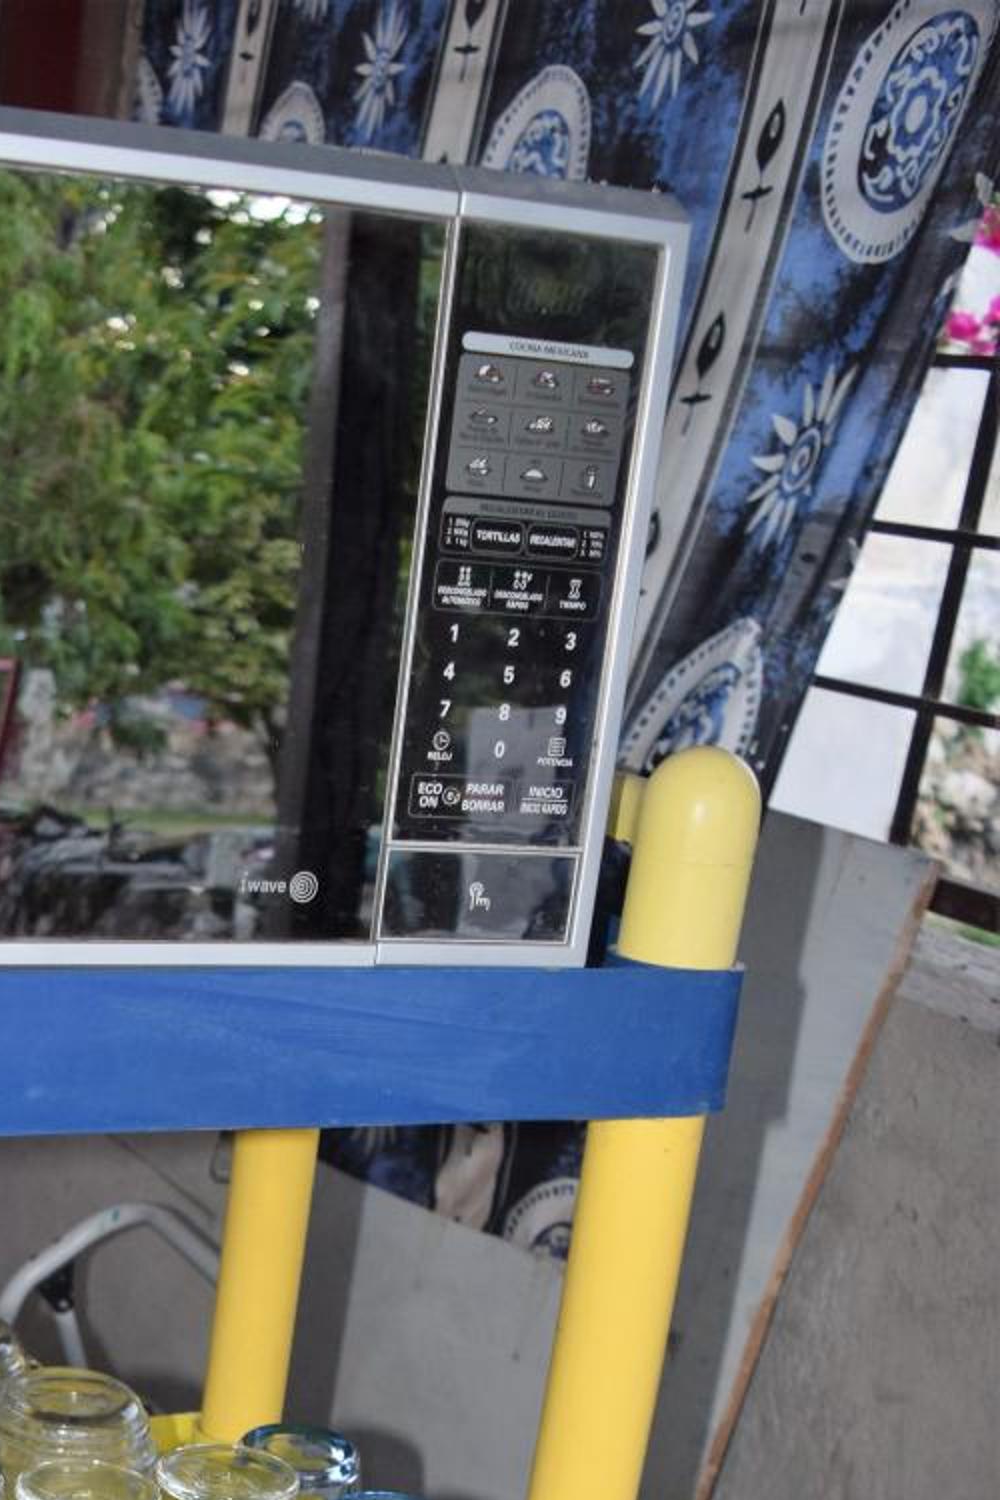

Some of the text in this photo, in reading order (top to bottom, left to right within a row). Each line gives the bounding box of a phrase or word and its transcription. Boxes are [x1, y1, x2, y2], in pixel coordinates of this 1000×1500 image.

[476, 529, 521, 544] TORTILLAS
[529, 534, 577, 549] RECALENTAR
[559, 600, 587, 611] TIEMPO
[450, 623, 459, 642] 1
[507, 628, 520, 647] 2
[564, 631, 577, 651] 3
[443, 661, 456, 680] 4
[503, 665, 516, 685] 5
[559, 669, 572, 689] 6
[440, 700, 451, 718] 7
[499, 703, 511, 722] 8
[554, 706, 567, 725] 9
[427, 751, 453, 762] RELOJ
[494, 740, 505, 759] 0
[536, 757, 573, 768] POTENCIA
[417, 782, 443, 796] ECO
[465, 782, 504, 796] PARAR
[528, 785, 564, 799] INICIO
[419, 795, 439, 808] ON
[461, 798, 505, 813] BORRAR
